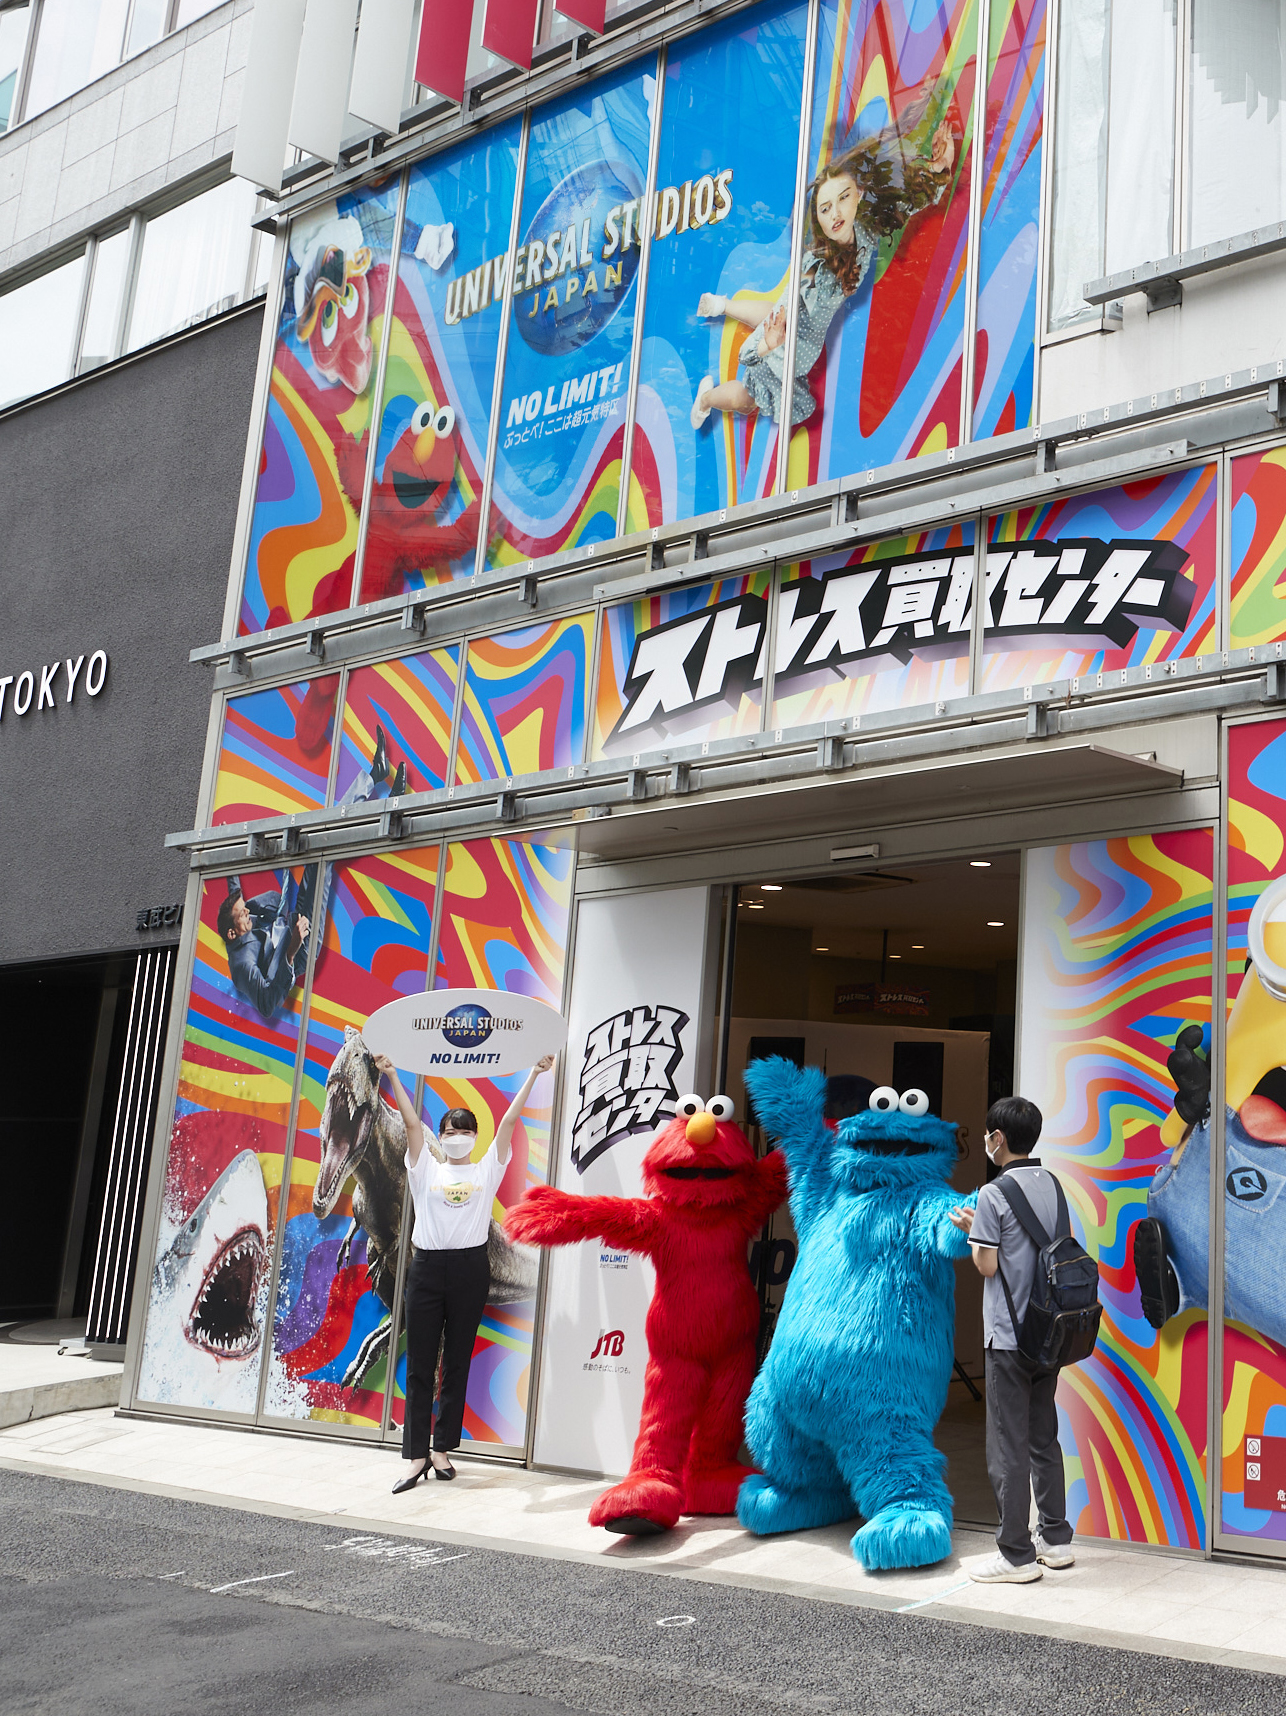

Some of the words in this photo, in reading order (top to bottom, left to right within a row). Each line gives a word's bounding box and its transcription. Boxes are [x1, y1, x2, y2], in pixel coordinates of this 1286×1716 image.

[444, 216, 594, 325] UNIVERSAL
[602, 168, 734, 259] STUDIOS
[529, 261, 623, 318] JAPAN
[506, 390, 542, 428] NO
[543, 362, 623, 411] LIMIT!
[616, 546, 1168, 735] ストレス買取センター
[0, 649, 107, 721] TOKYO
[412, 1017, 474, 1030] UNIVERSAL
[477, 1017, 524, 1031] STUDIOS
[581, 1006, 683, 1076] ストレス
[429, 1053, 452, 1064] NO
[453, 1053, 501, 1064] LIMIT!
[600, 1254, 609, 1262] NO
[609, 1254, 629, 1264] LIMIT!
[590, 1329, 625, 1360] JTB
